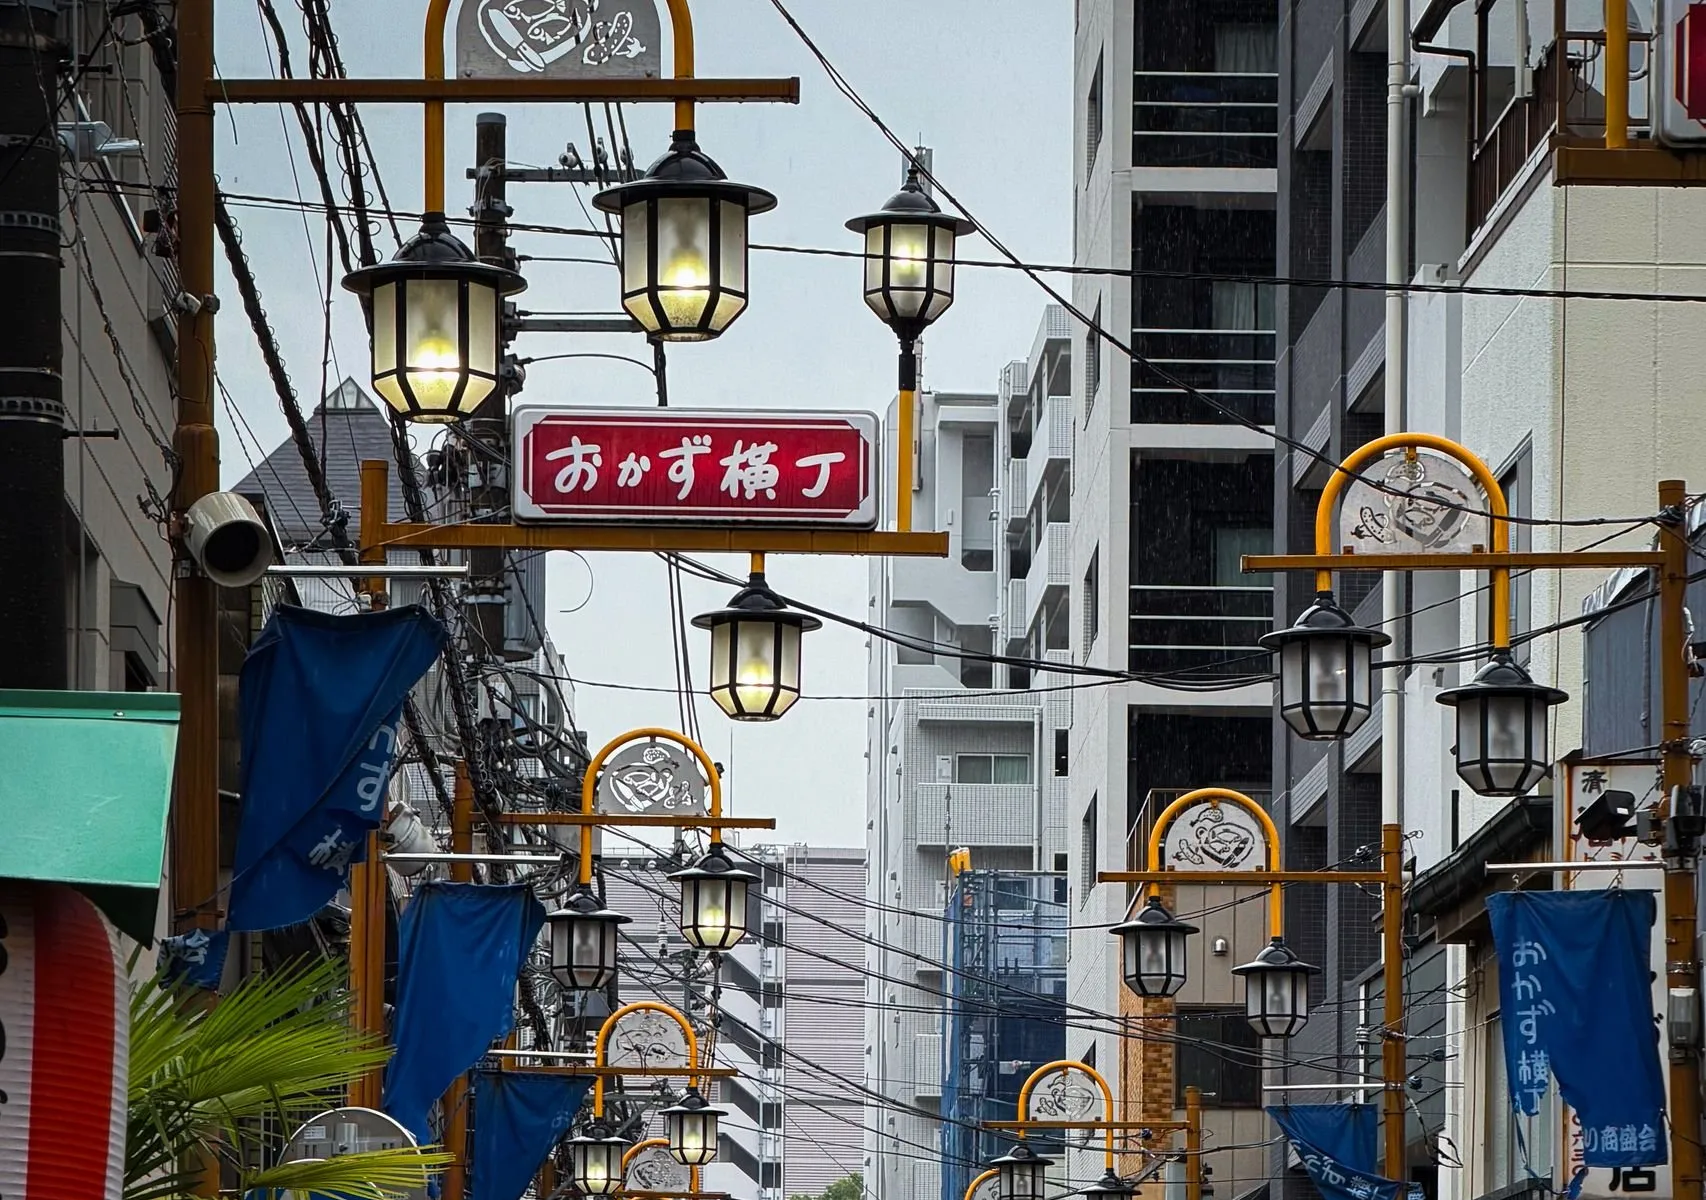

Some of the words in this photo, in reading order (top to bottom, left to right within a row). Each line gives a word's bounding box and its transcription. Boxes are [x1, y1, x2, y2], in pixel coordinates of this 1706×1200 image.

[545, 435, 846, 500] おかず横丁
[1511, 937, 1556, 1113] おかず横丁
